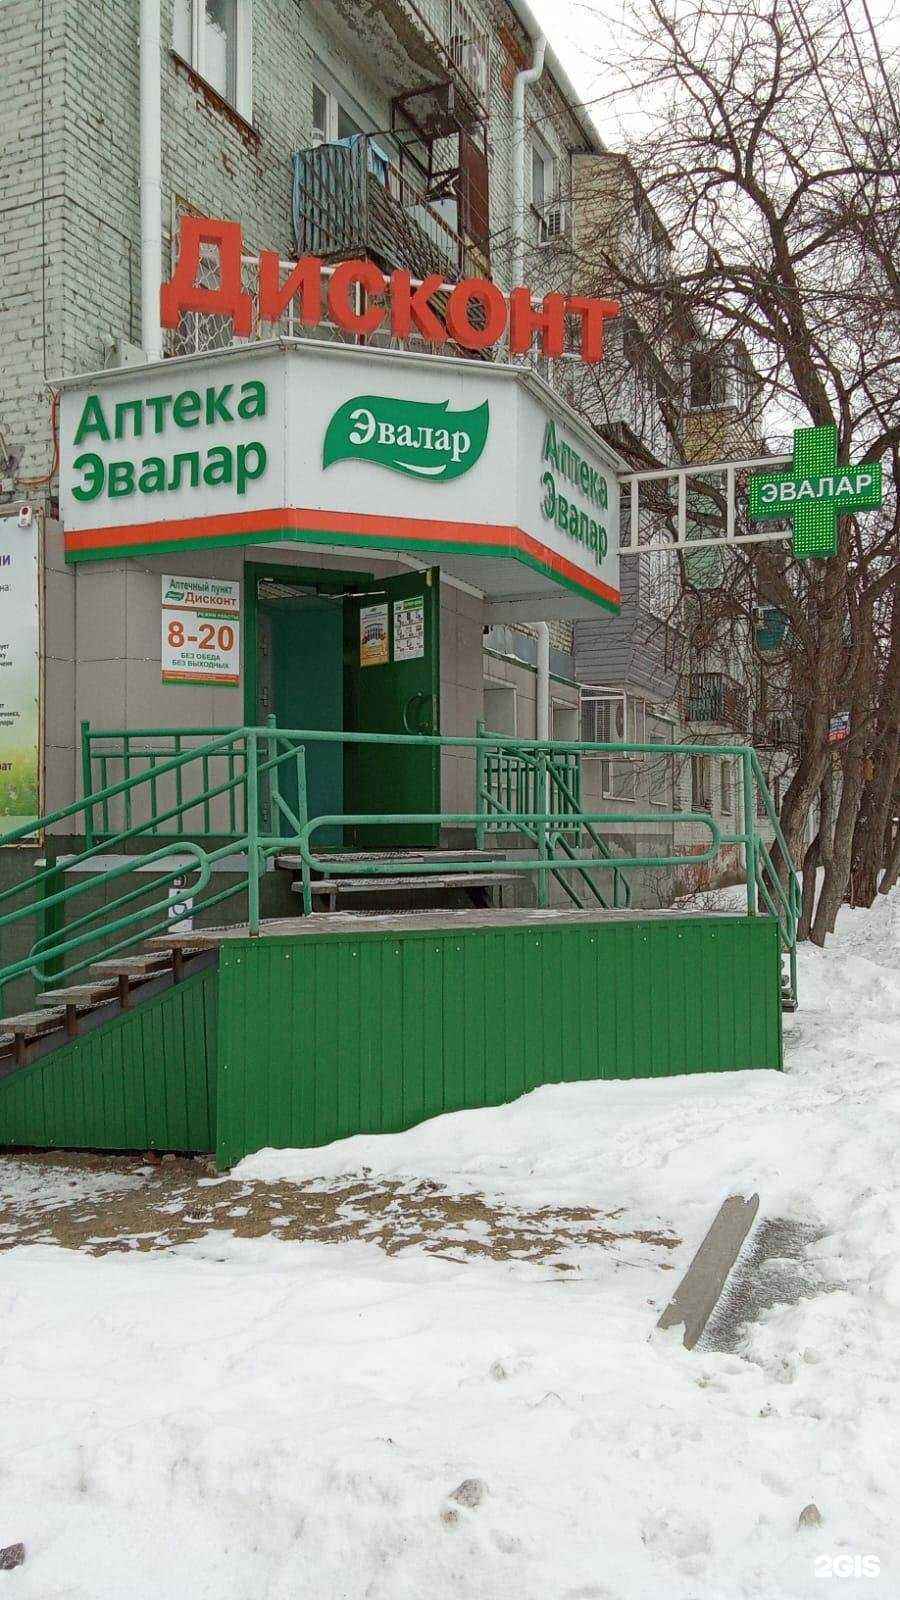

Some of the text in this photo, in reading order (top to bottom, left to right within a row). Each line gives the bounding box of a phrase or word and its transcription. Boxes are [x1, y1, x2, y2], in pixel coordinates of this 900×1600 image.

[160, 216, 620, 364] Дисконт
[73, 379, 267, 446] Аптека
[348, 408, 471, 463] Эвалар
[71, 440, 268, 501] Эвалар
[542, 420, 609, 511] Аптека
[760, 473, 873, 504] ЭВАЛАР
[540, 471, 608, 566] Эвалар
[170, 579, 232, 595] Аптечный пункт
[185, 592, 236, 605] Дисконт
[168, 621, 234, 651] 8-20
[180, 652, 221, 661] БЕЗ ОБЕДА
[171, 659, 186, 667] БЕЗ
